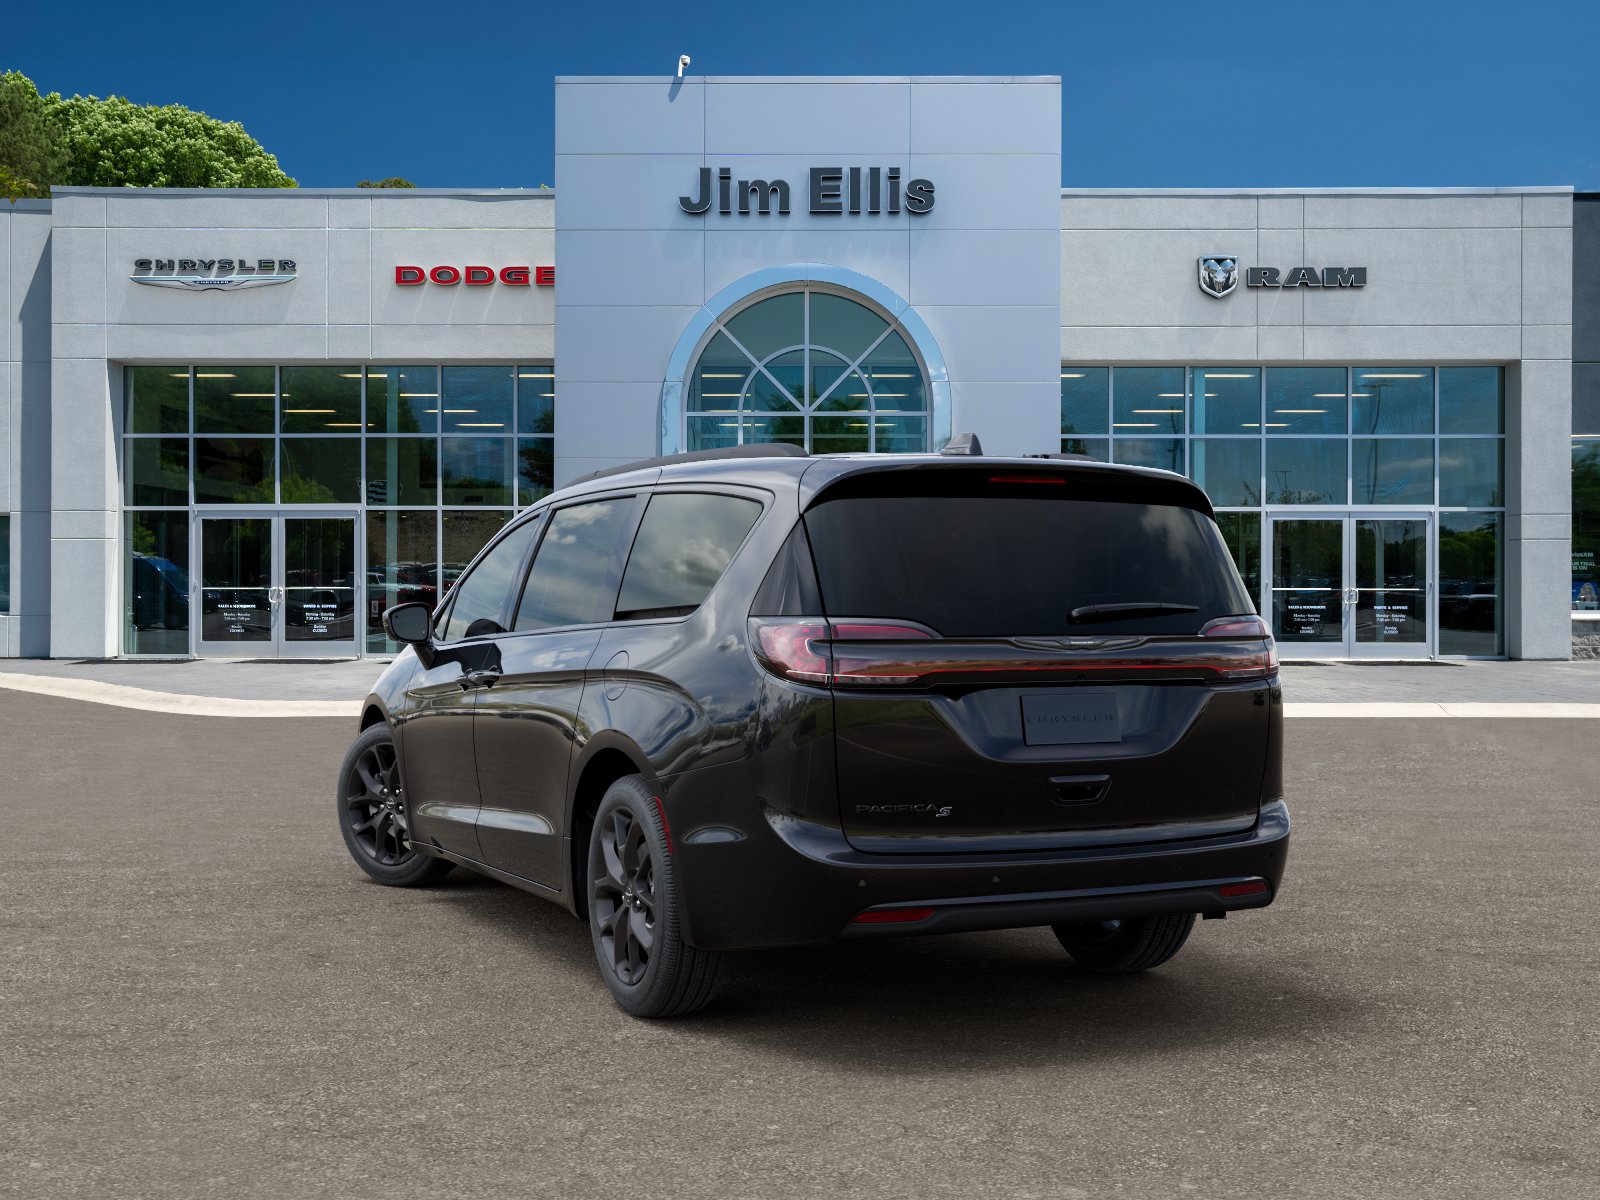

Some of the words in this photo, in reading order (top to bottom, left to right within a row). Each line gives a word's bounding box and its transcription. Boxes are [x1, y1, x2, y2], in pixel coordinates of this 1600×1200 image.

[679, 167, 790, 214] Jim
[809, 167, 936, 214] Ellis
[134, 259, 297, 271] CHRYSLER
[396, 266, 555, 286] DODGE
[1247, 267, 1367, 287] RAM
[1027, 712, 1113, 723] CHRYSLER
[856, 804, 938, 813] PACIFICA
[936, 806, 952, 817] S
